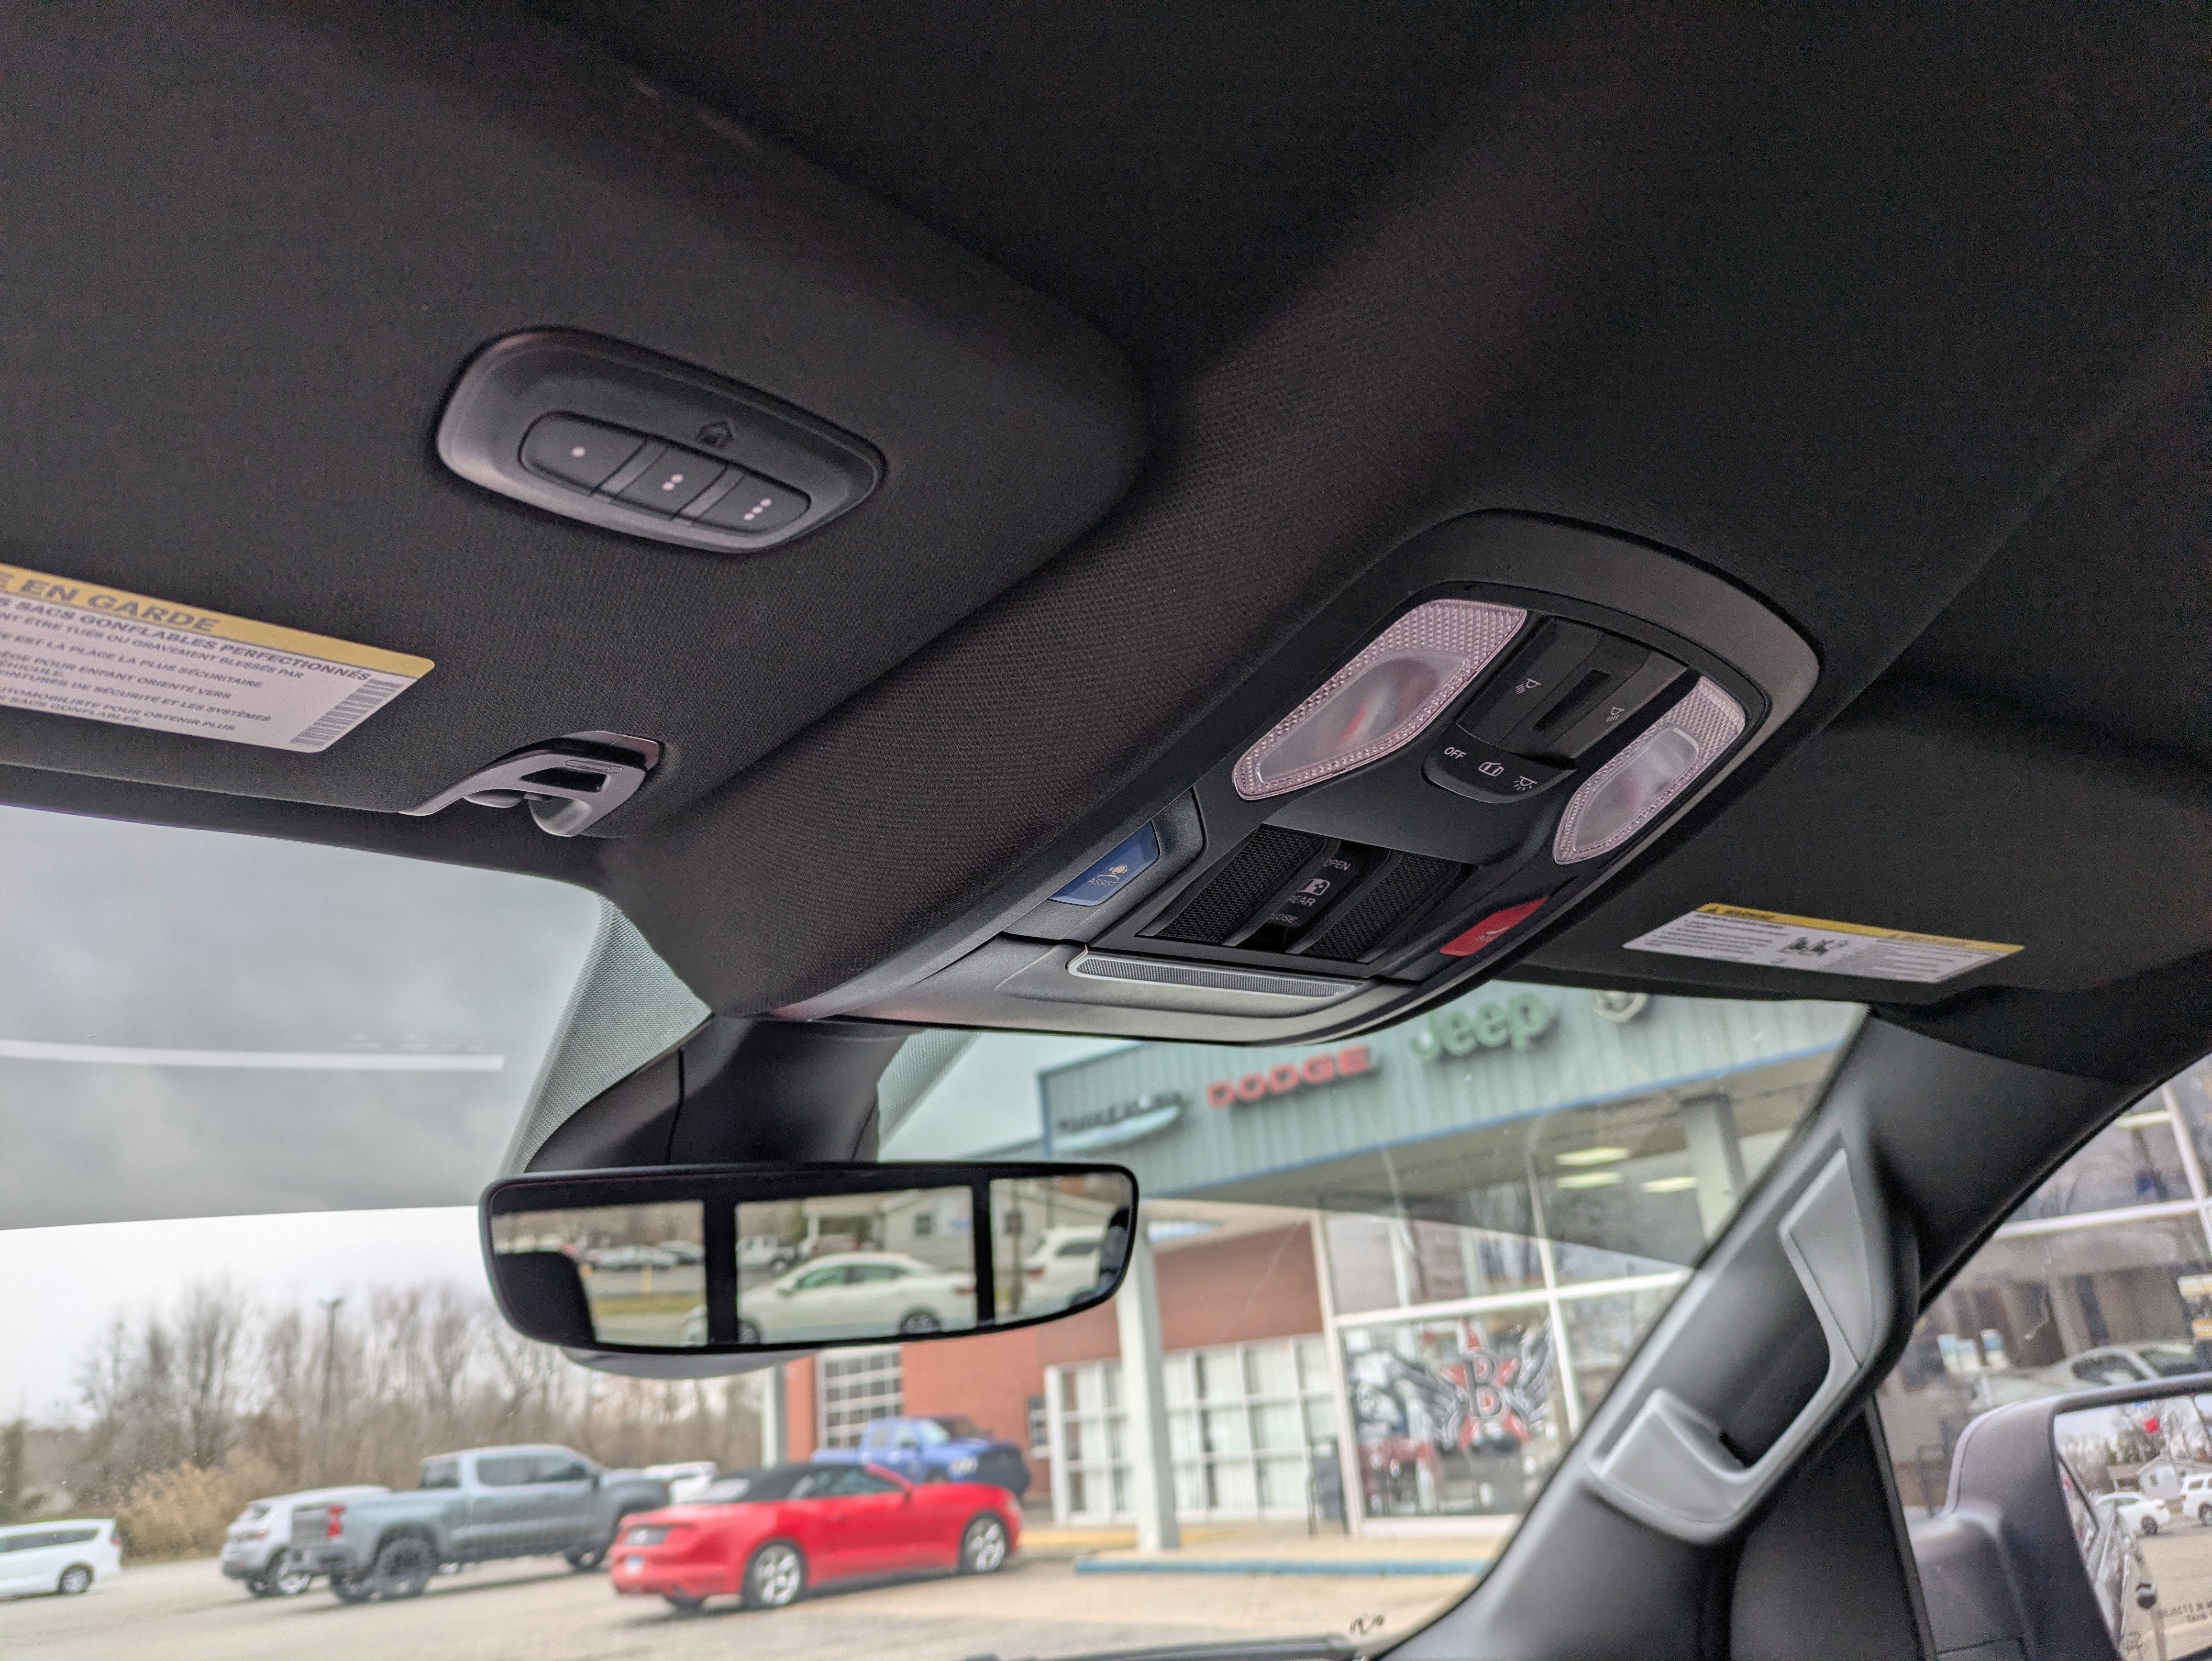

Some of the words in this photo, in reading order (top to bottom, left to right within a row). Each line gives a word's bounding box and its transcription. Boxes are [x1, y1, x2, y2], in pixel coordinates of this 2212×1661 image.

[20, 579, 79, 601] EN
[88, 595, 220, 632] GARDE
[15, 601, 76, 619] SACS
[80, 615, 218, 650] GONFLABLES
[219, 644, 372, 680] PERFECTIONNÉS
[118, 654, 136, 664] LA
[139, 659, 177, 672] PLUS
[132, 640, 219, 662] GRAVEMENT
[277, 668, 304, 679] PAR
[33, 657, 77, 671] POUR
[78, 665, 136, 682] ENFANT
[198, 687, 232, 699] VERS
[180, 701, 205, 711] LES
[202, 720, 236, 731] PLUS
[1444, 747, 1467, 759] OFF
[1324, 859, 1351, 871] OPEN
[1086, 878, 1118, 887] ASSIST
[1409, 994, 1548, 1062] Jeep
[1206, 1044, 1370, 1109] DODGE
